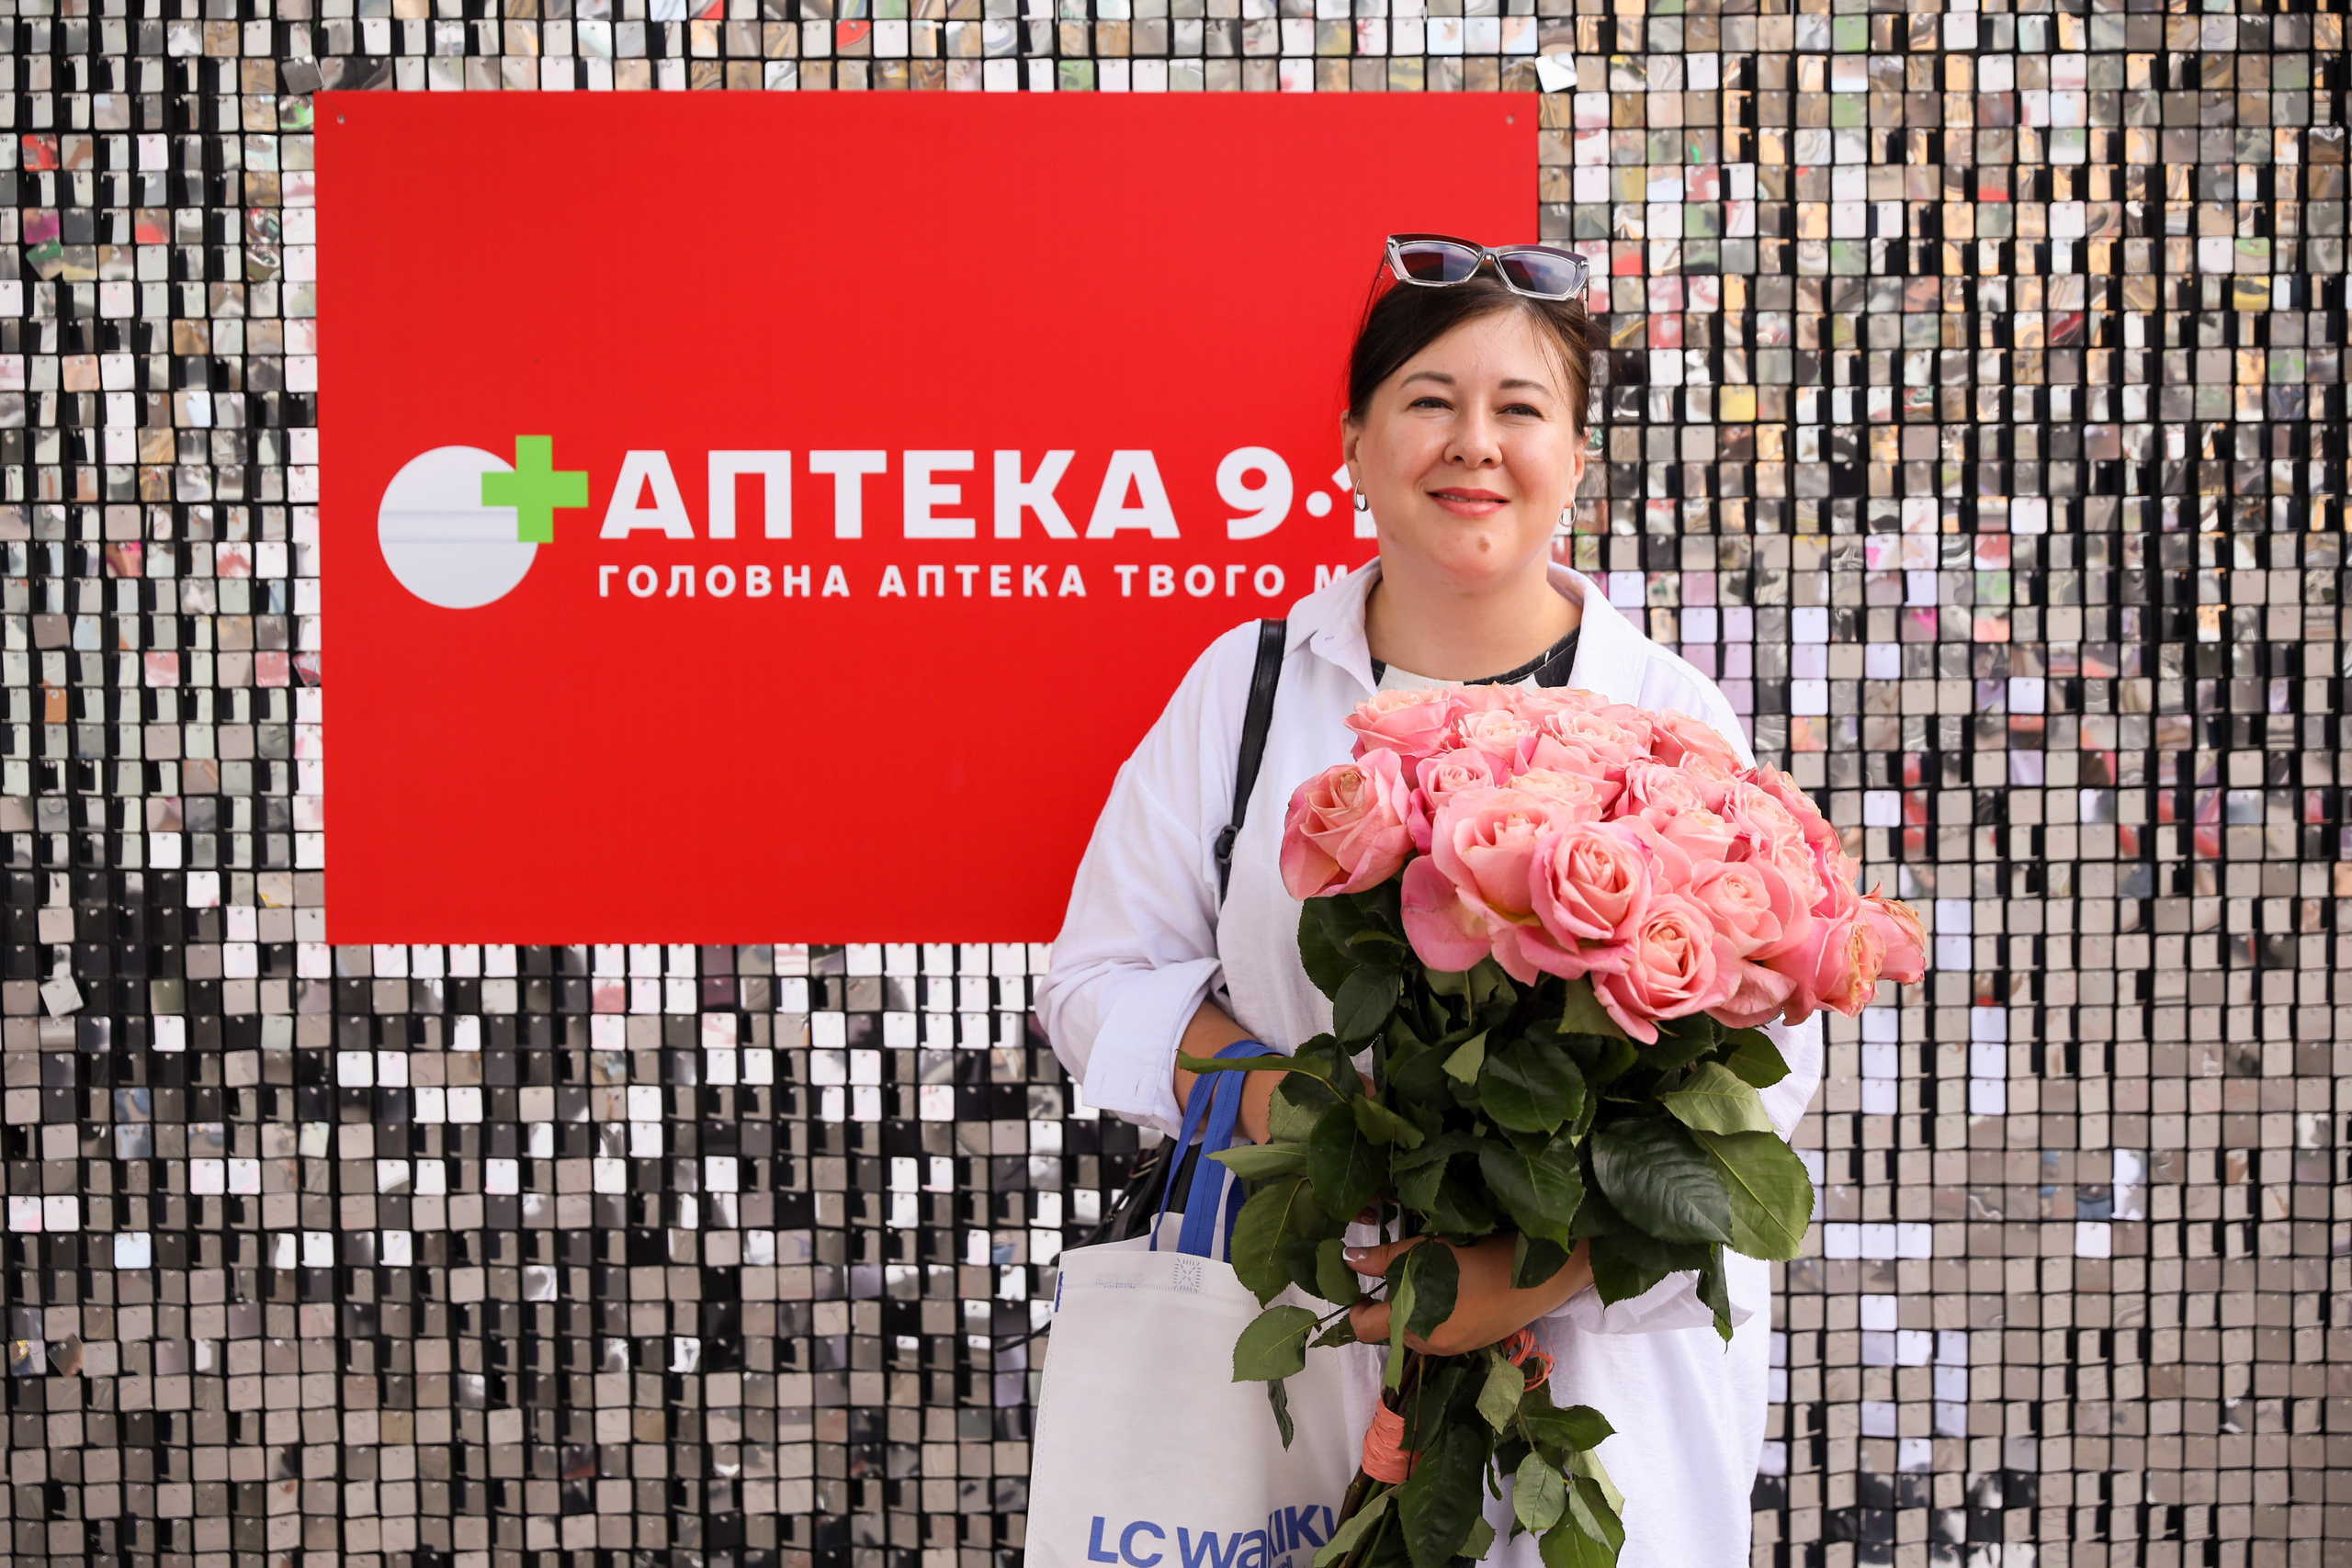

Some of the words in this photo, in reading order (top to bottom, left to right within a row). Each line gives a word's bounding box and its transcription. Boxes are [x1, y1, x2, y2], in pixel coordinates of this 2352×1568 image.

[599, 449, 1181, 539] АПТЕКА
[598, 564, 851, 598] ГОЛОВНА
[877, 564, 1087, 598] АПТЕКА
[1114, 564, 1285, 598] ТВОГО
[1088, 1516, 1166, 1568] LC
